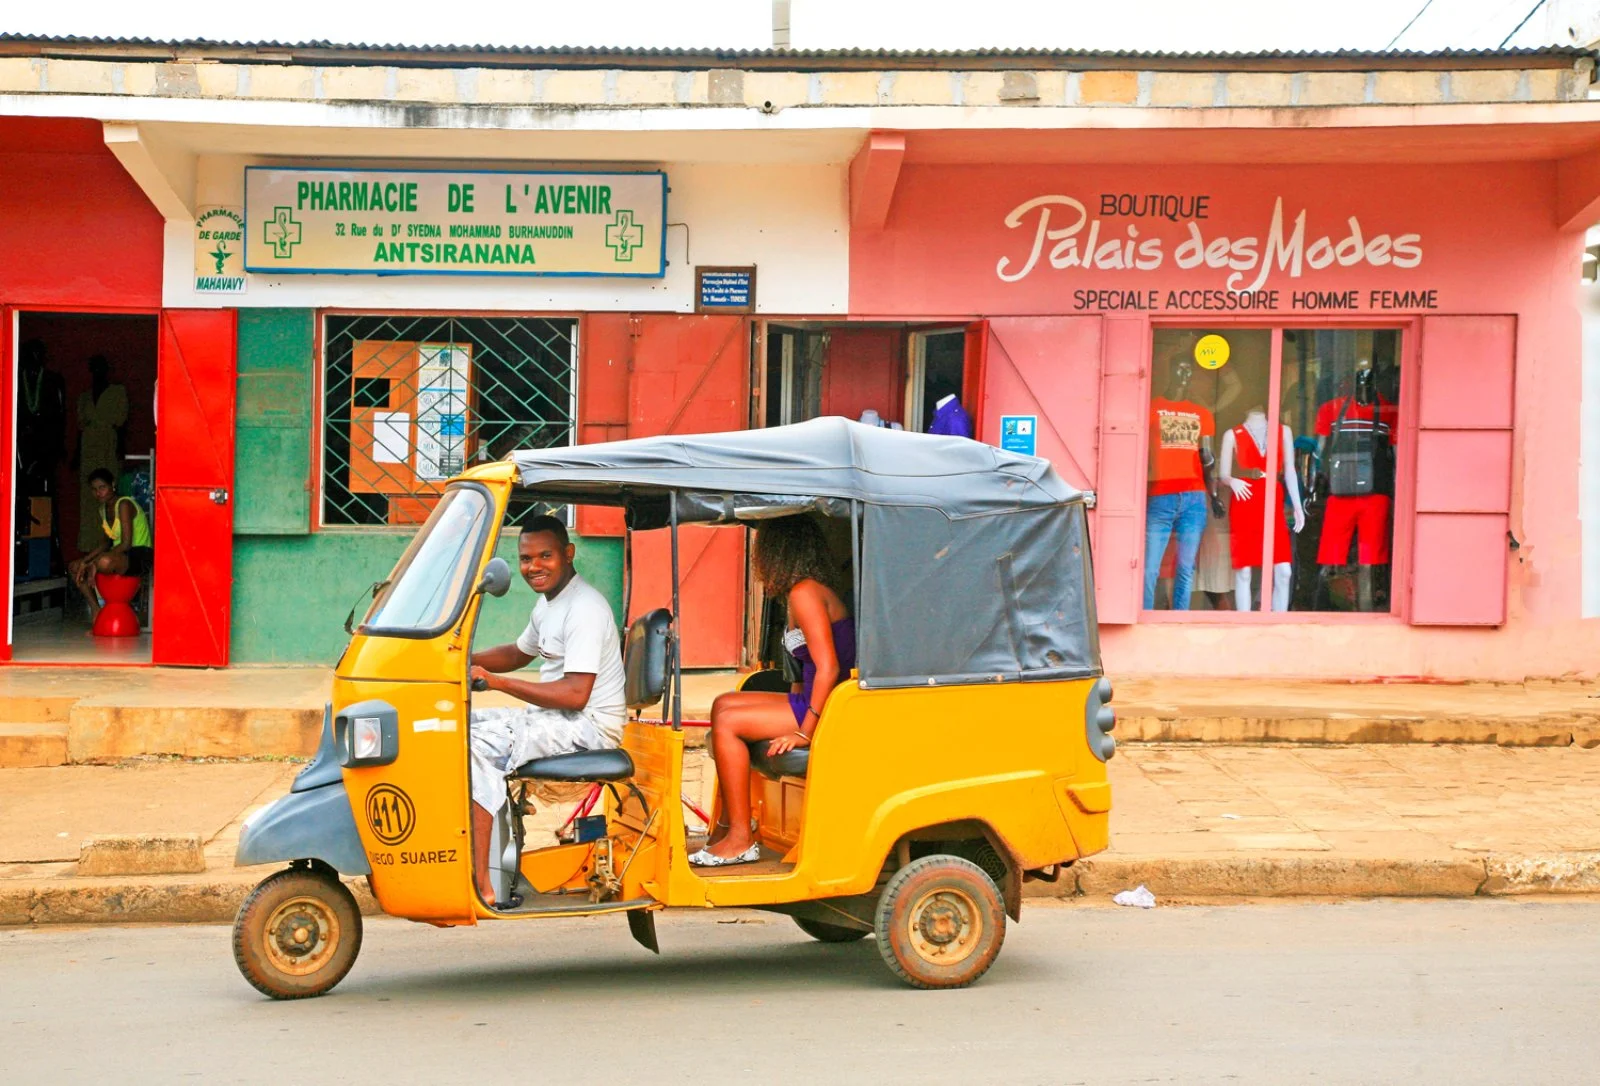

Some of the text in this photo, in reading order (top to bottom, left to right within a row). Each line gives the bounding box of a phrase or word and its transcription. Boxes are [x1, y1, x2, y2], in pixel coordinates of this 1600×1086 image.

[297, 181, 418, 213] PHARMACIE
[447, 183, 475, 213] DE
[196, 209, 245, 229] PHARMACIE
[1099, 194, 1211, 223] BOUTIQUE
[198, 231, 242, 241] DE GARDE
[335, 222, 574, 239] 32 Rue du Dr SYEDNA MOHAMMAD BURHANUDDIN
[373, 242, 536, 265] ANTSIRANANA
[996, 195, 1424, 295] Palais des Modes
[195, 277, 245, 291] MAHAVAVY
[1073, 289, 1438, 311] SPECIALE ACCESSOIRE HOMME FEMME
[373, 796, 403, 833] 411
[400, 849, 458, 865] SUAREZ
